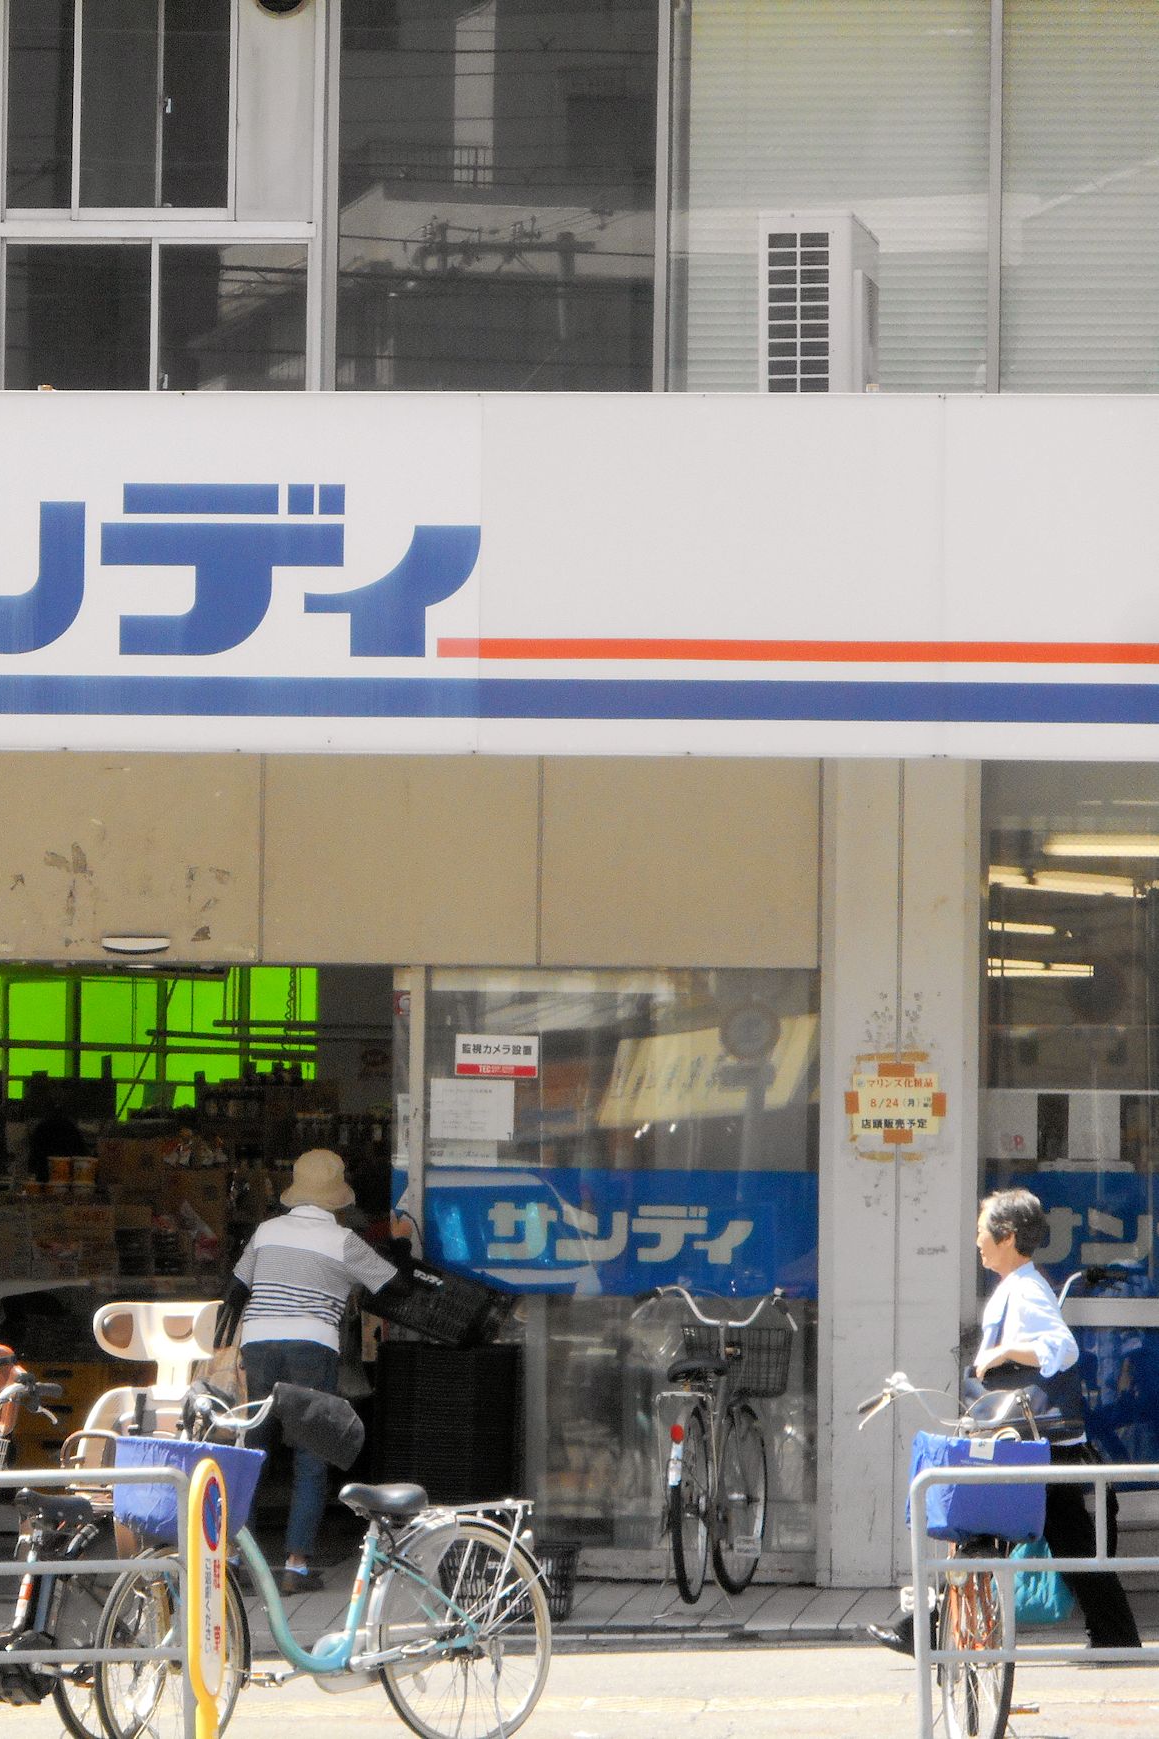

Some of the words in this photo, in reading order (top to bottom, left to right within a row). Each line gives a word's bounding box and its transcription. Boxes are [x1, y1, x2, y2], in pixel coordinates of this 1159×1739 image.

[462, 1043, 532, 1055] 監視カメラ設置
[487, 1202, 753, 1265] サンディ
